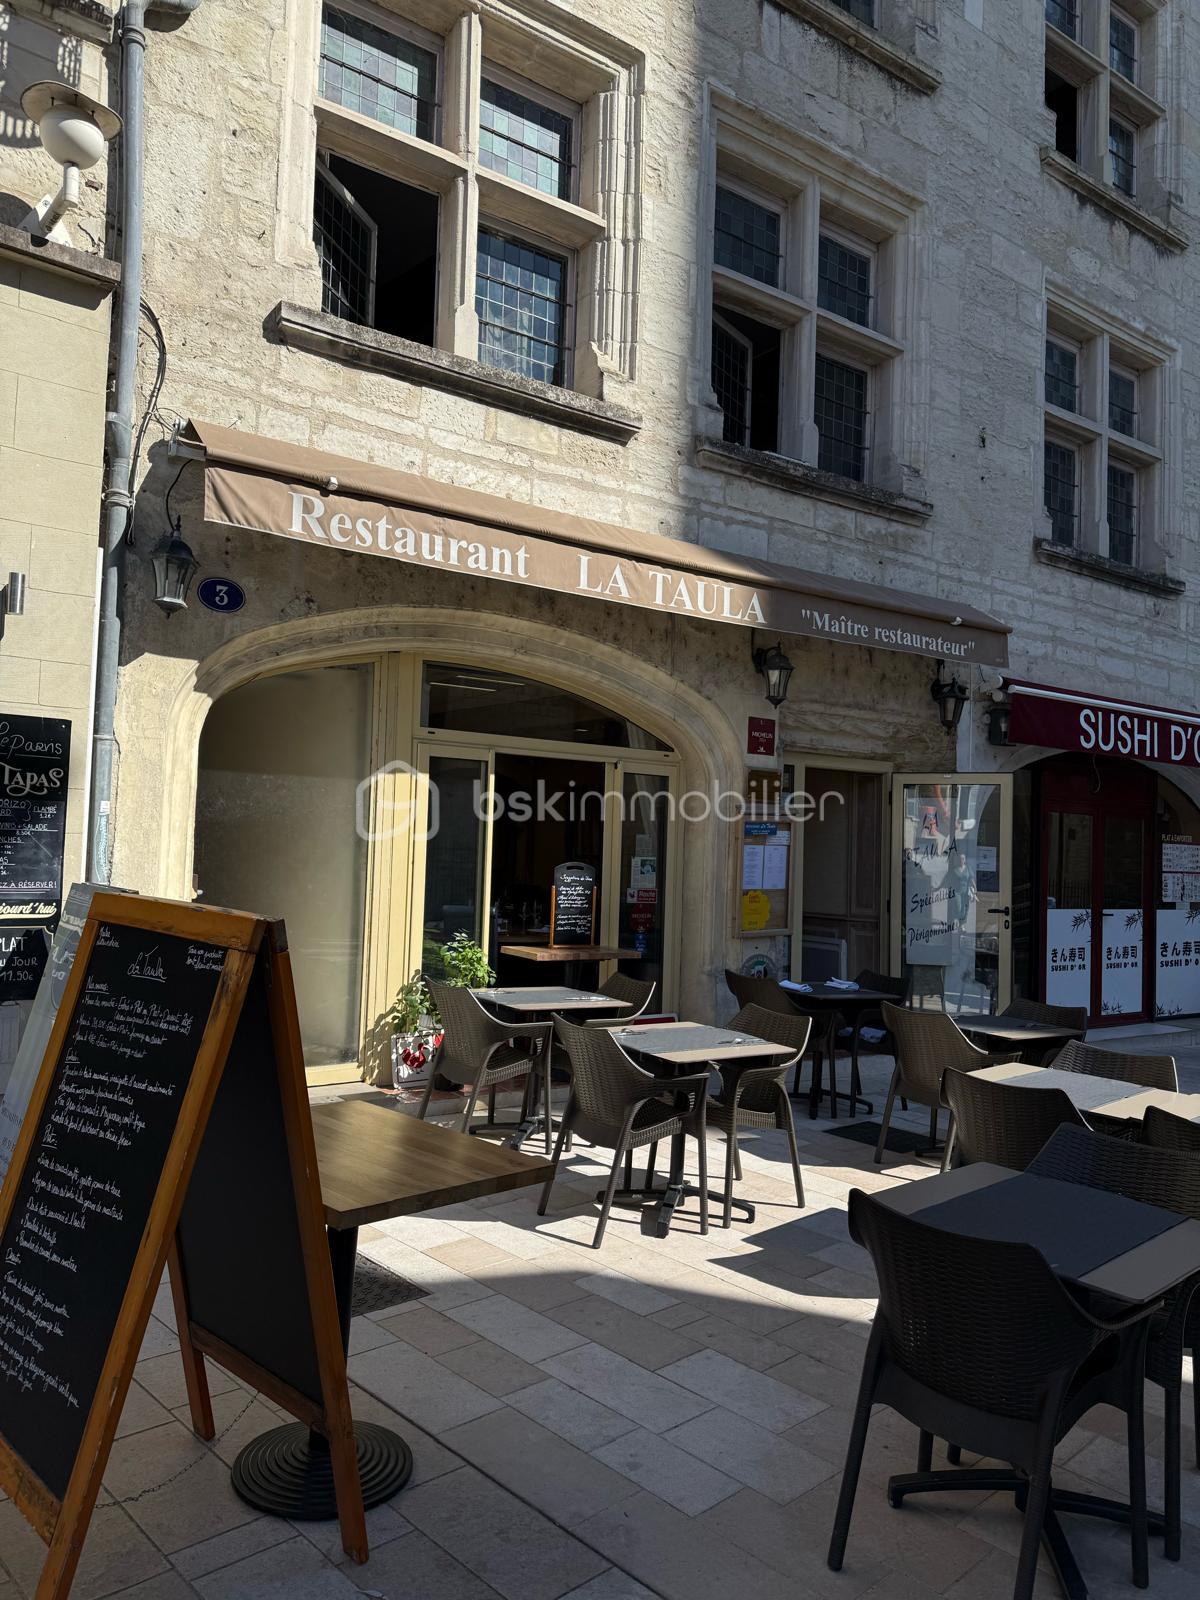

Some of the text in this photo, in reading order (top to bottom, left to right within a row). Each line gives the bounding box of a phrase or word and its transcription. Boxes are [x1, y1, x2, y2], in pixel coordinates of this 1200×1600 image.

[288, 491, 767, 624] Restaurant LA TAULA
[215, 585, 229, 606] 3
[801, 609, 976, 657] "Maître restaurateur"
[1079, 708, 1158, 758] SUSHI
[1051, 947, 1086, 963] きん寿司
[1106, 945, 1138, 960] きん寿司
[12, 955, 39, 968] JOUR
[1051, 964, 1069, 972] SUSHI
[1160, 959, 1182, 968] SUSHI
